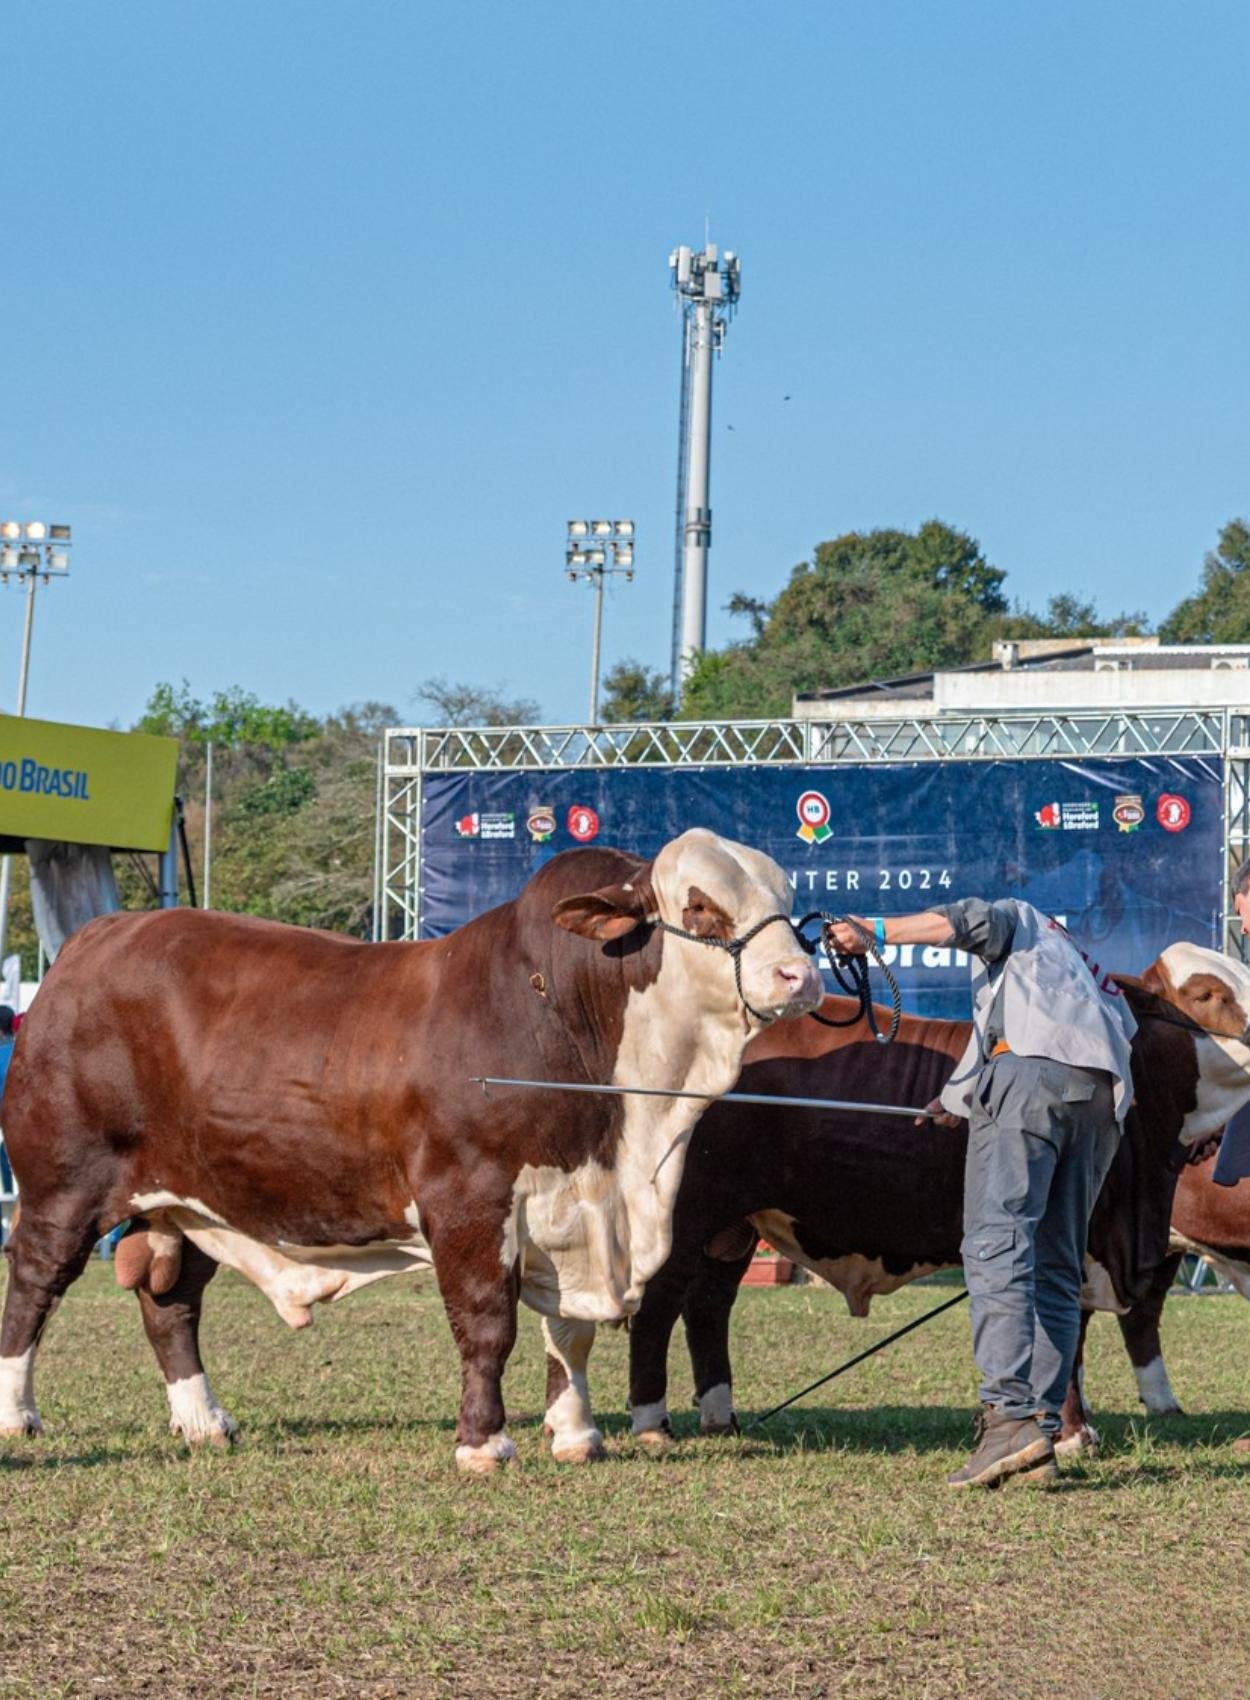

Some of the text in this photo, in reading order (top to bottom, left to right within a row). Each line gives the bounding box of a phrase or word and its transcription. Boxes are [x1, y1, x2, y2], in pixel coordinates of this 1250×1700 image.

[0, 757, 90, 801] O BRASIL
[878, 869, 953, 890] 2024
